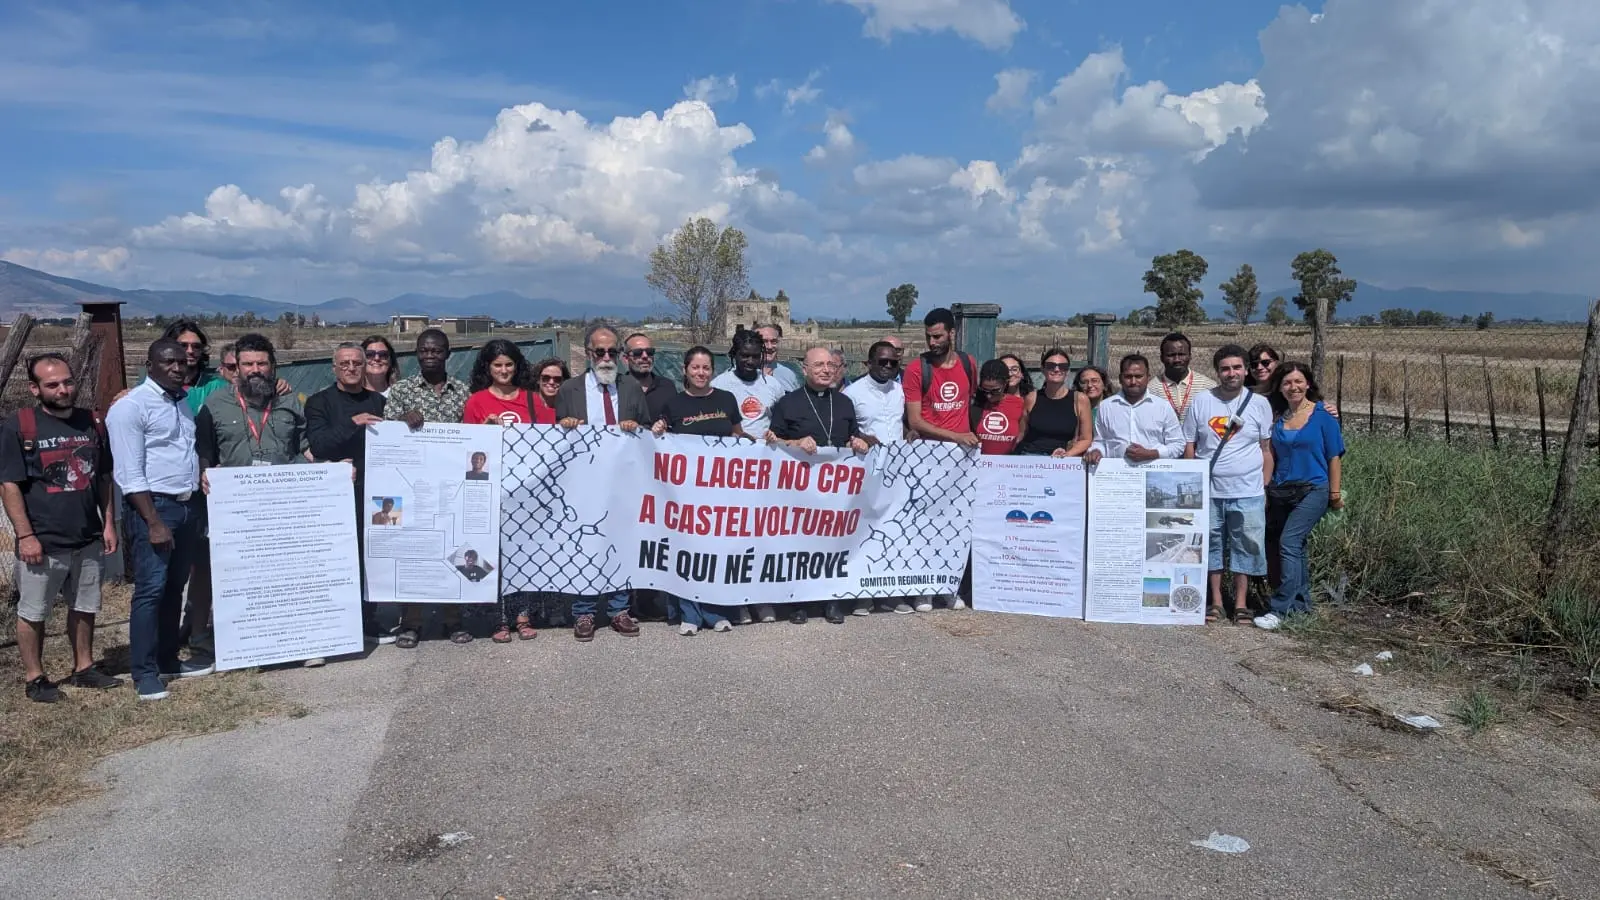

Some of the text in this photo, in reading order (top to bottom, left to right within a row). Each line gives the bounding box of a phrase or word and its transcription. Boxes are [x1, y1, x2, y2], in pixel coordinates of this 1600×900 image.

[654, 452, 865, 495] NO LAGER NO CPR
[639, 494, 655, 524] A
[639, 537, 849, 584] NÉ QUI NÉ ALTROVE
[860, 577, 895, 587] COMITATO
[898, 575, 934, 585] REGIONALE
[937, 575, 946, 584] NO
